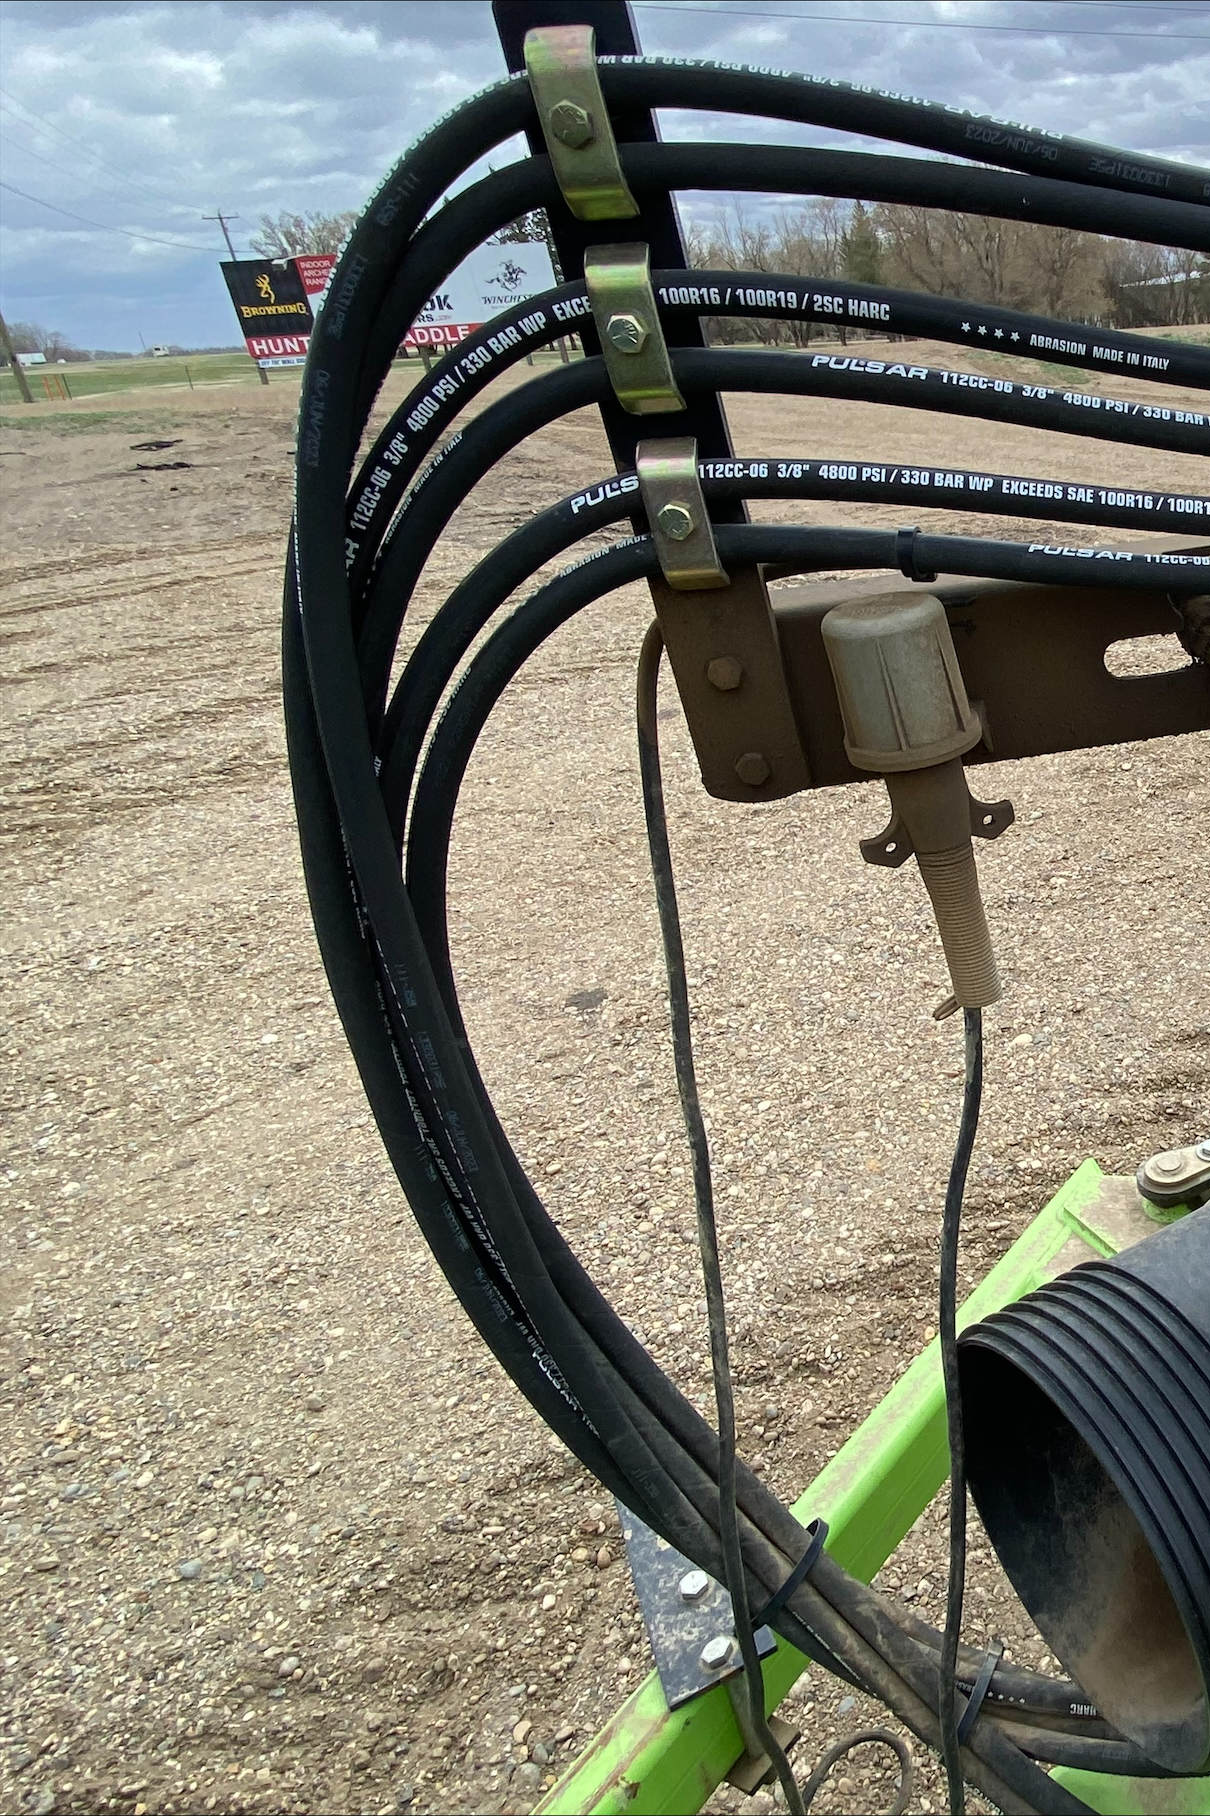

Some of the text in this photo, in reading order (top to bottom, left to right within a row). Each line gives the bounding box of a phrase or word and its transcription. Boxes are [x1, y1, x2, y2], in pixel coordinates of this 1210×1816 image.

[300, 260, 332, 269] INDOOR
[303, 269, 330, 278] ARCHE
[240, 302, 307, 319] BROWNING
[658, 287, 891, 322] 100R16 100R19 2SC HARC
[404, 325, 472, 345] ADDLE
[1029, 333, 1170, 372] ABRASION MADE IN ITALY
[811, 354, 929, 381] PULSAR
[940, 370, 1014, 395] 112CC-06
[1022, 384, 1055, 400] 3/8"
[1062, 391, 1102, 410] 4800
[1104, 399, 1129, 415] PSI
[1142, 405, 1171, 421] 330
[1174, 410, 1205, 427] BAR
[349, 466, 392, 532] 112CC-06
[383, 431, 410, 467] 3/8"
[406, 395, 442, 434] 4800
[431, 374, 460, 402] PSI
[460, 344, 493, 375] 330
[487, 326, 521, 355] BAR
[517, 311, 548, 336] WP
[570, 474, 641, 515] PULS
[698, 462, 769, 480] 112CC-06
[777, 463, 810, 479] 3/8"
[818, 464, 858, 481] 4800
[861, 466, 886, 483] PSI
[901, 469, 930, 486] 330
[934, 472, 964, 489] BAR
[968, 475, 995, 492] WP
[1001, 479, 1064, 500] EXCEEDS
[1067, 486, 1095, 504] SAE
[1097, 490, 1154, 511] 100R16
